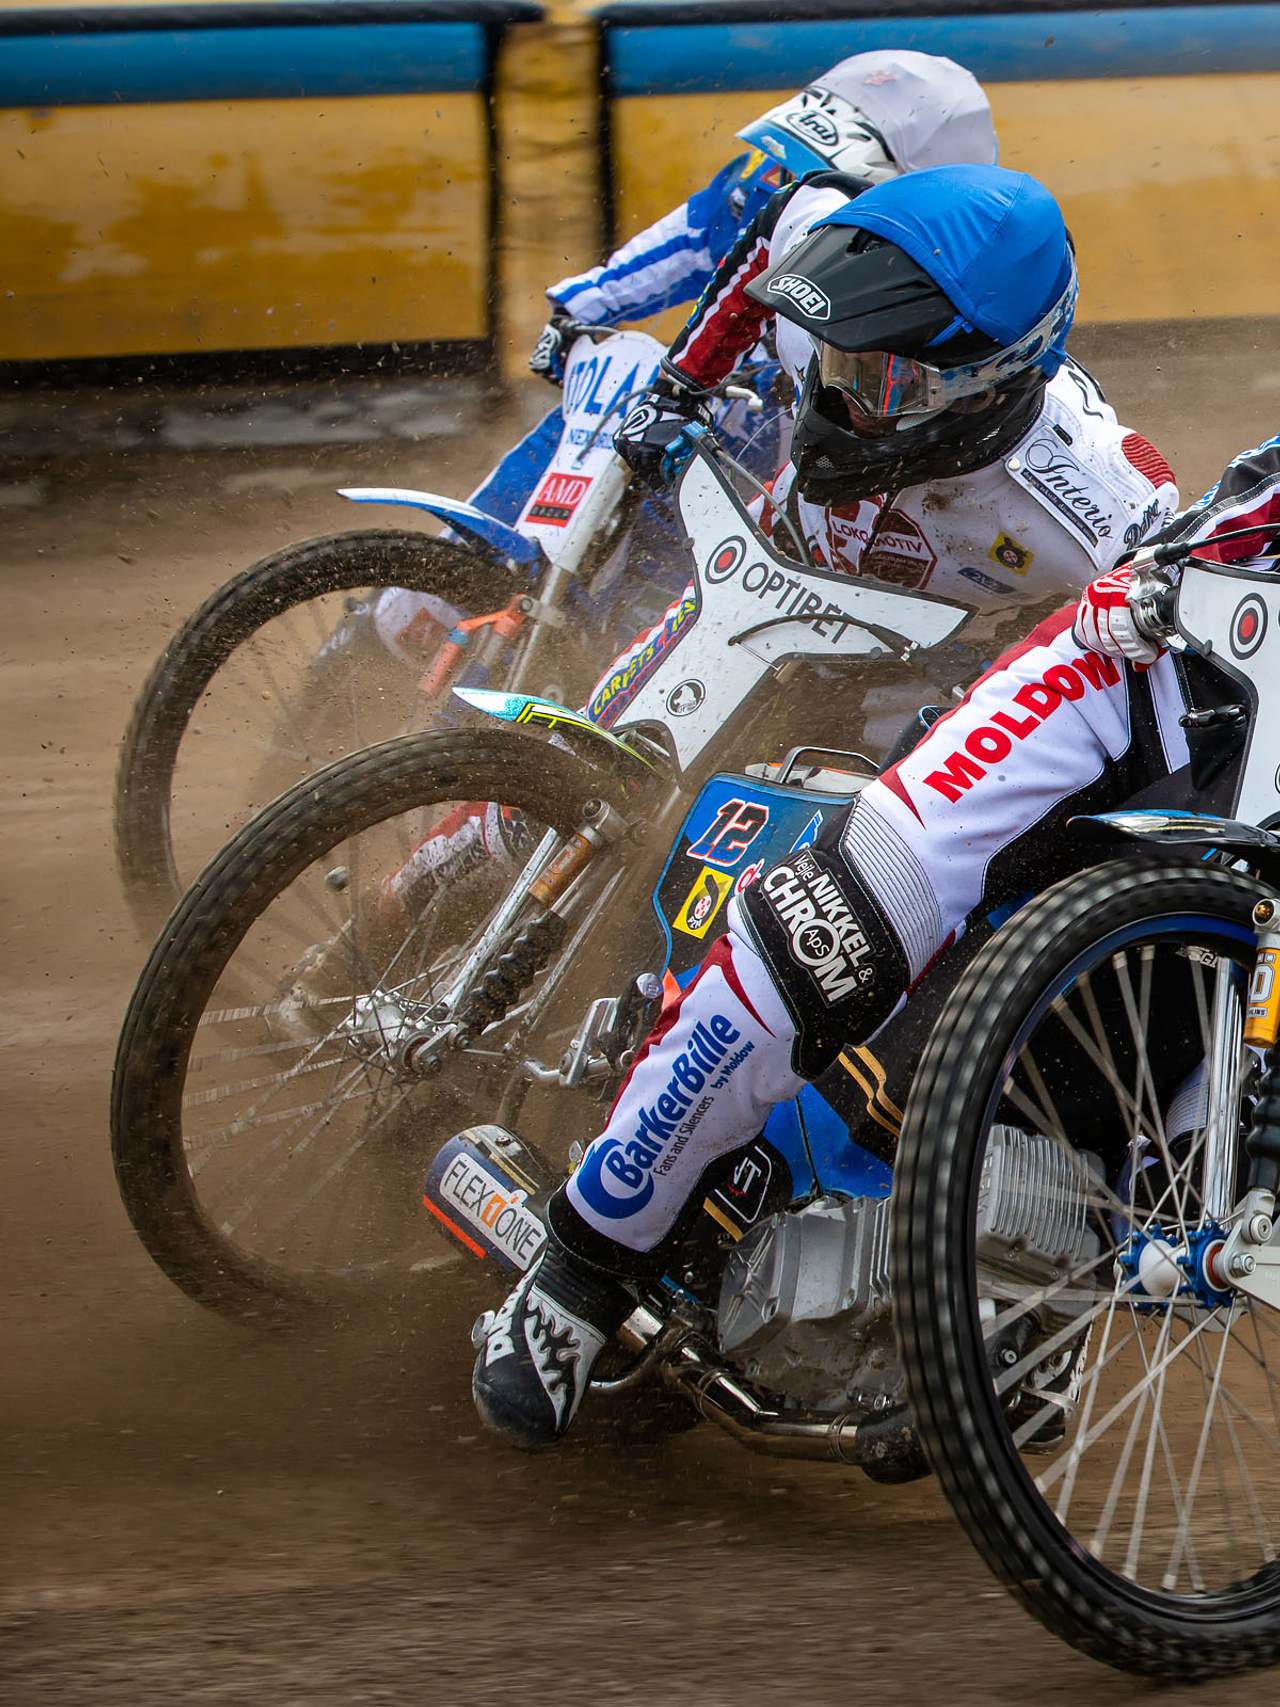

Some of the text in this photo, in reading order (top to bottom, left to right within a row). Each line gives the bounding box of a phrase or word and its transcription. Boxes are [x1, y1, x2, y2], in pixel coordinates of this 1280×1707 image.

[771, 276, 826, 315] SHOEI
[537, 477, 587, 505] AMD
[1025, 438, 1114, 539] Interio
[742, 562, 854, 644] OPTIBET
[922, 651, 1121, 804] MOLDOW
[686, 798, 769, 867] 12
[763, 866, 857, 1002] CHROM
[794, 853, 873, 984] Vejle NIKKEL &
[805, 929, 829, 957] ApS
[606, 1014, 740, 1189] BarkerBille
[711, 1041, 756, 1090] by Moldow
[653, 1095, 714, 1176] Fans and Silencers
